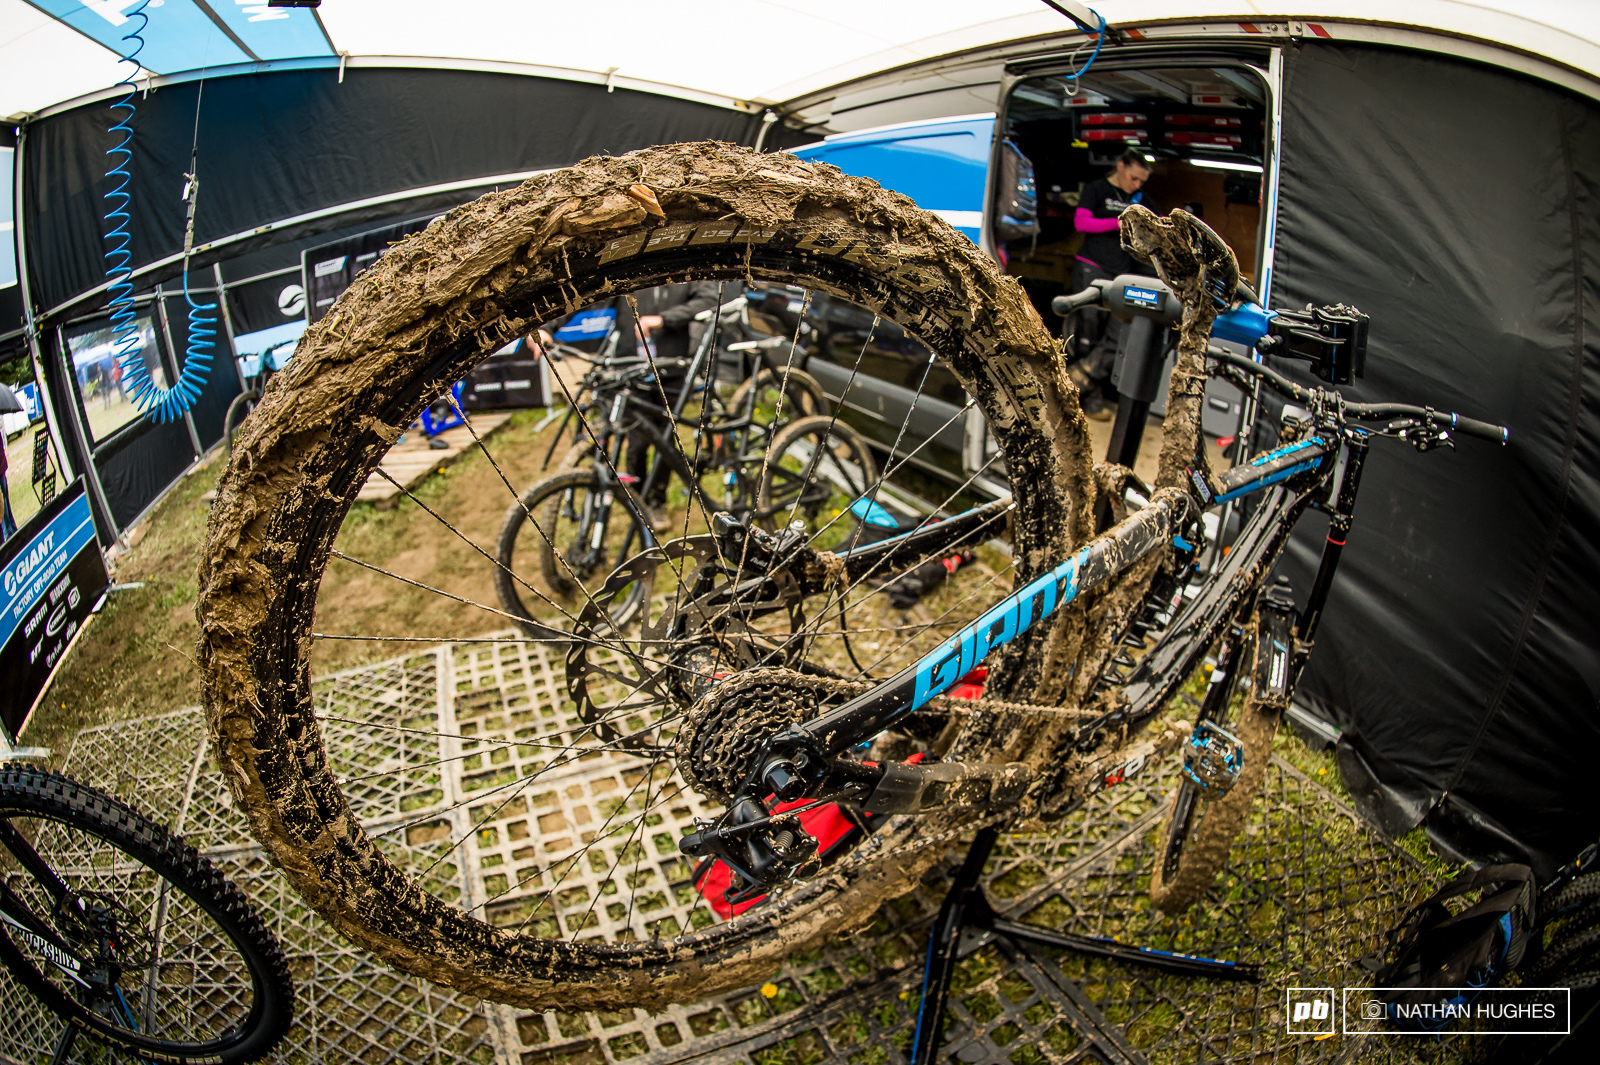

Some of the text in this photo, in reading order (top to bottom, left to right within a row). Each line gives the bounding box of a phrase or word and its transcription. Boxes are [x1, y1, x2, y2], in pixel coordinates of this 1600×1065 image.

[13, 587, 35, 619] FACTORY
[54, 549, 68, 569] TEAM
[16, 530, 55, 584] GIANT
[24, 602, 48, 638] SRAM
[911, 547, 1090, 712] GIANT
[71, 1015, 131, 1049] DIRTY
[138, 1049, 181, 1064] DAN
